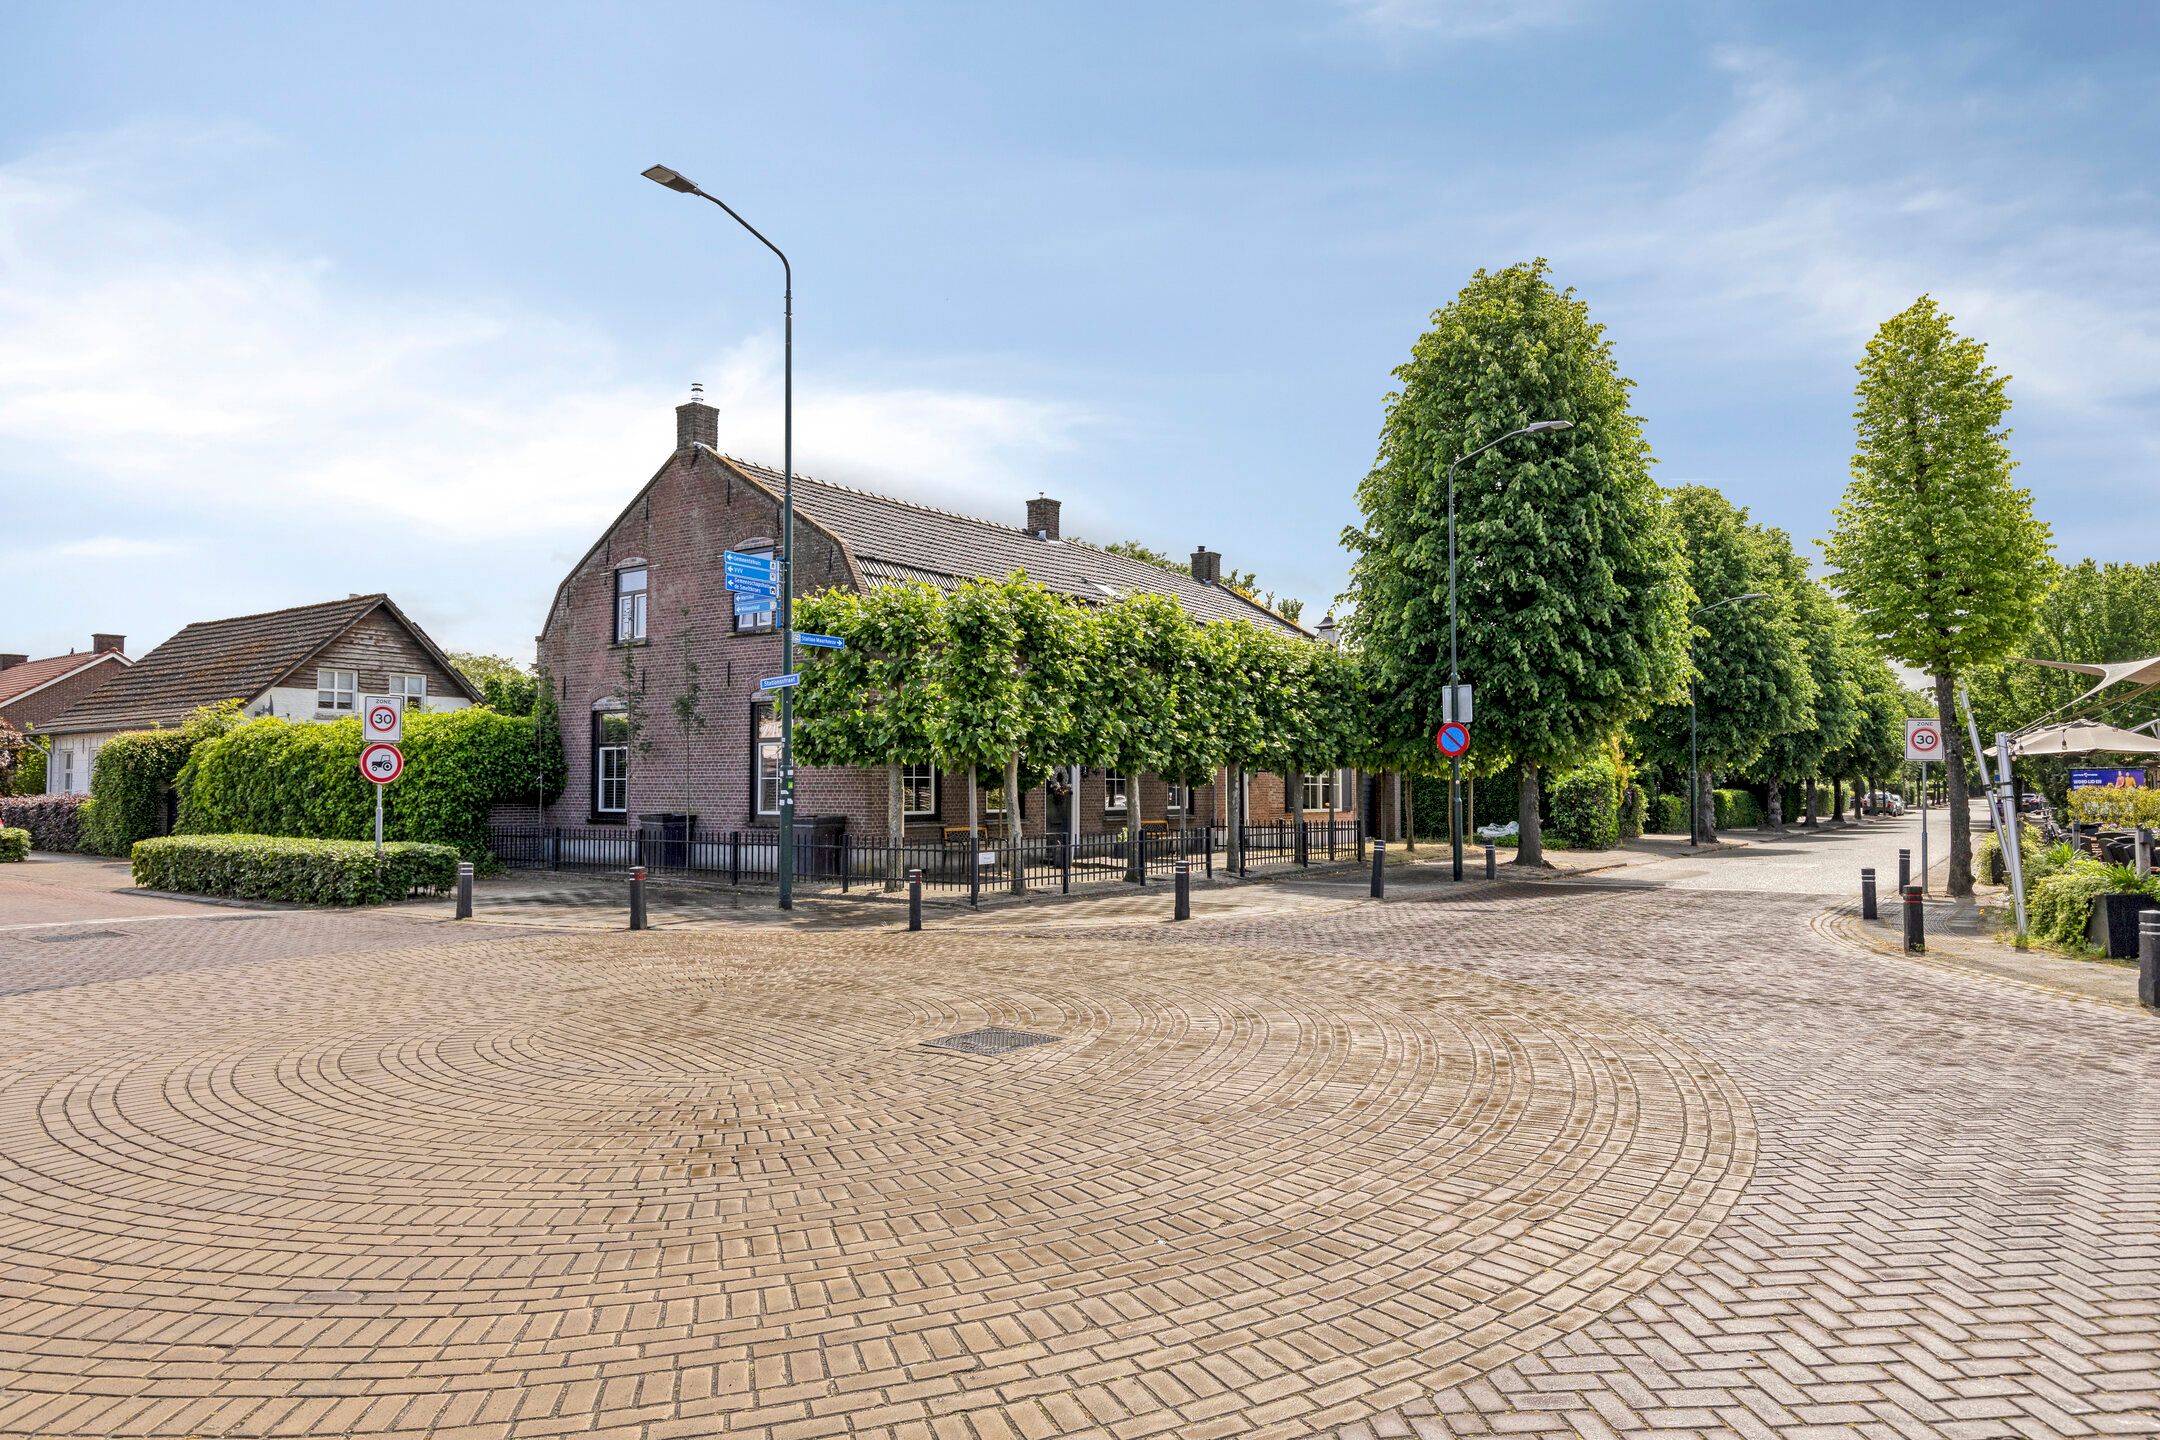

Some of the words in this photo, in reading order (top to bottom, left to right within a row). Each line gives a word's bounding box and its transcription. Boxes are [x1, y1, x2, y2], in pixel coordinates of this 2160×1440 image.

[763, 676, 796, 687] Stationsstraat
[374, 713, 393, 724] 30
[1916, 735, 1935, 745] 30
